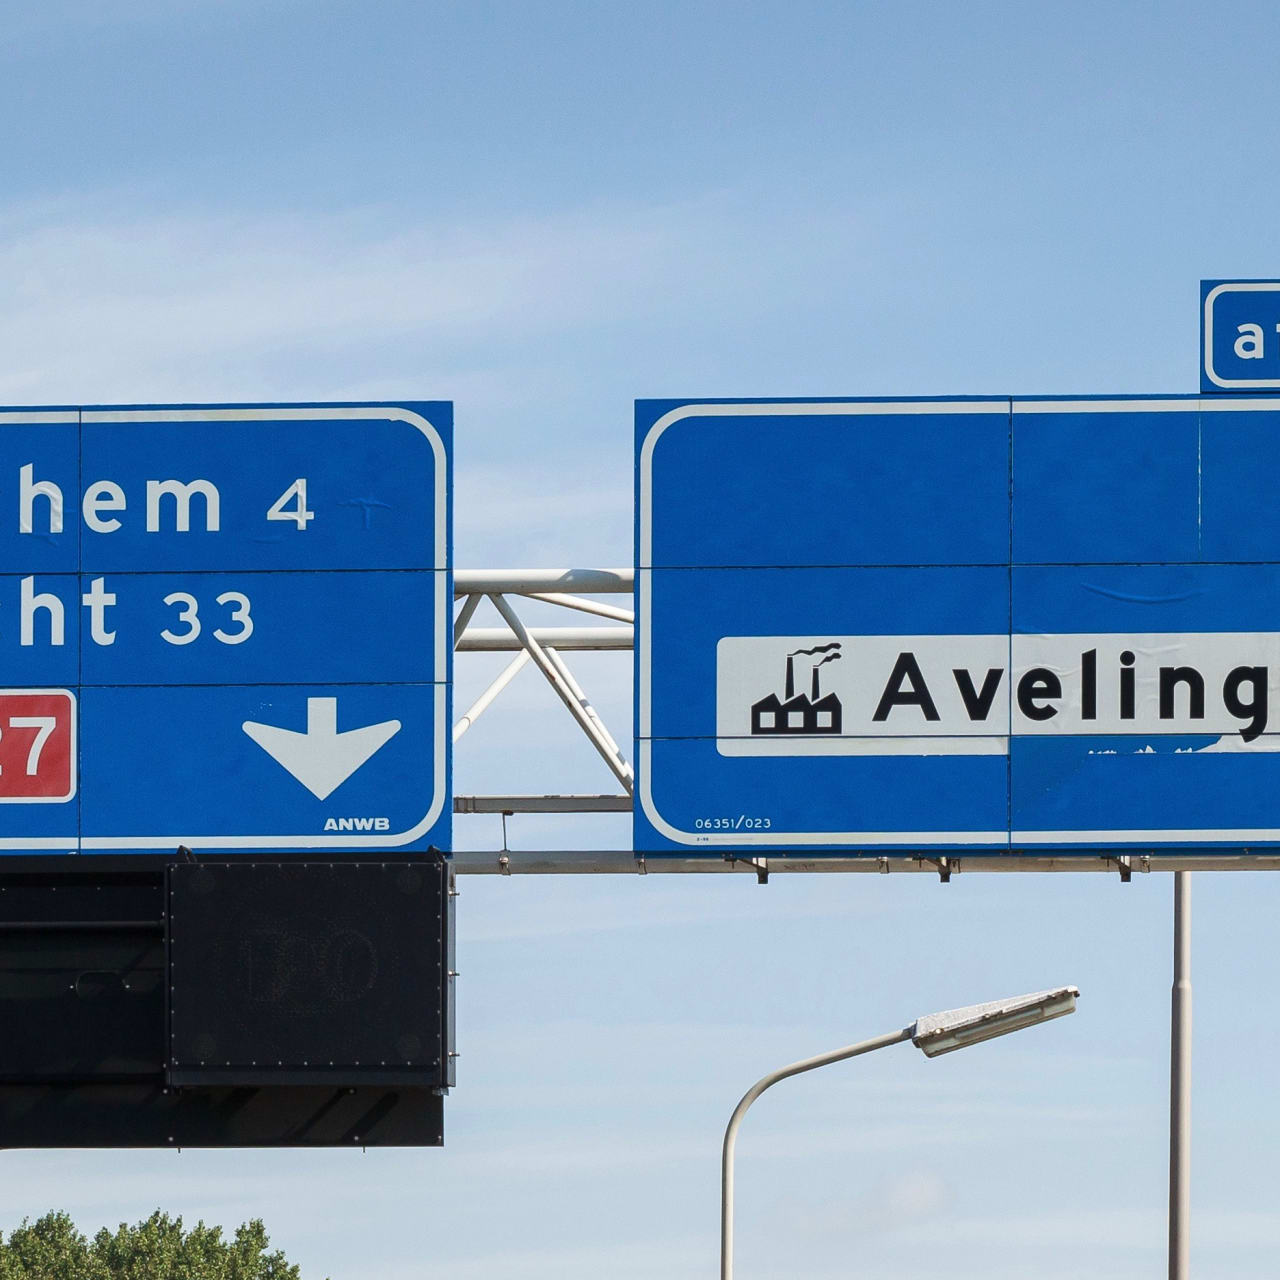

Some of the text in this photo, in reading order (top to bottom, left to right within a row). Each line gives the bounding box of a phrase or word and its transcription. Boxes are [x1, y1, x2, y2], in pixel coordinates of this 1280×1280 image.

[265, 478, 315, 532] 4
[159, 591, 255, 646] 33
[323, 817, 390, 831] ANWB
[695, 814, 771, 829] 06351/023
